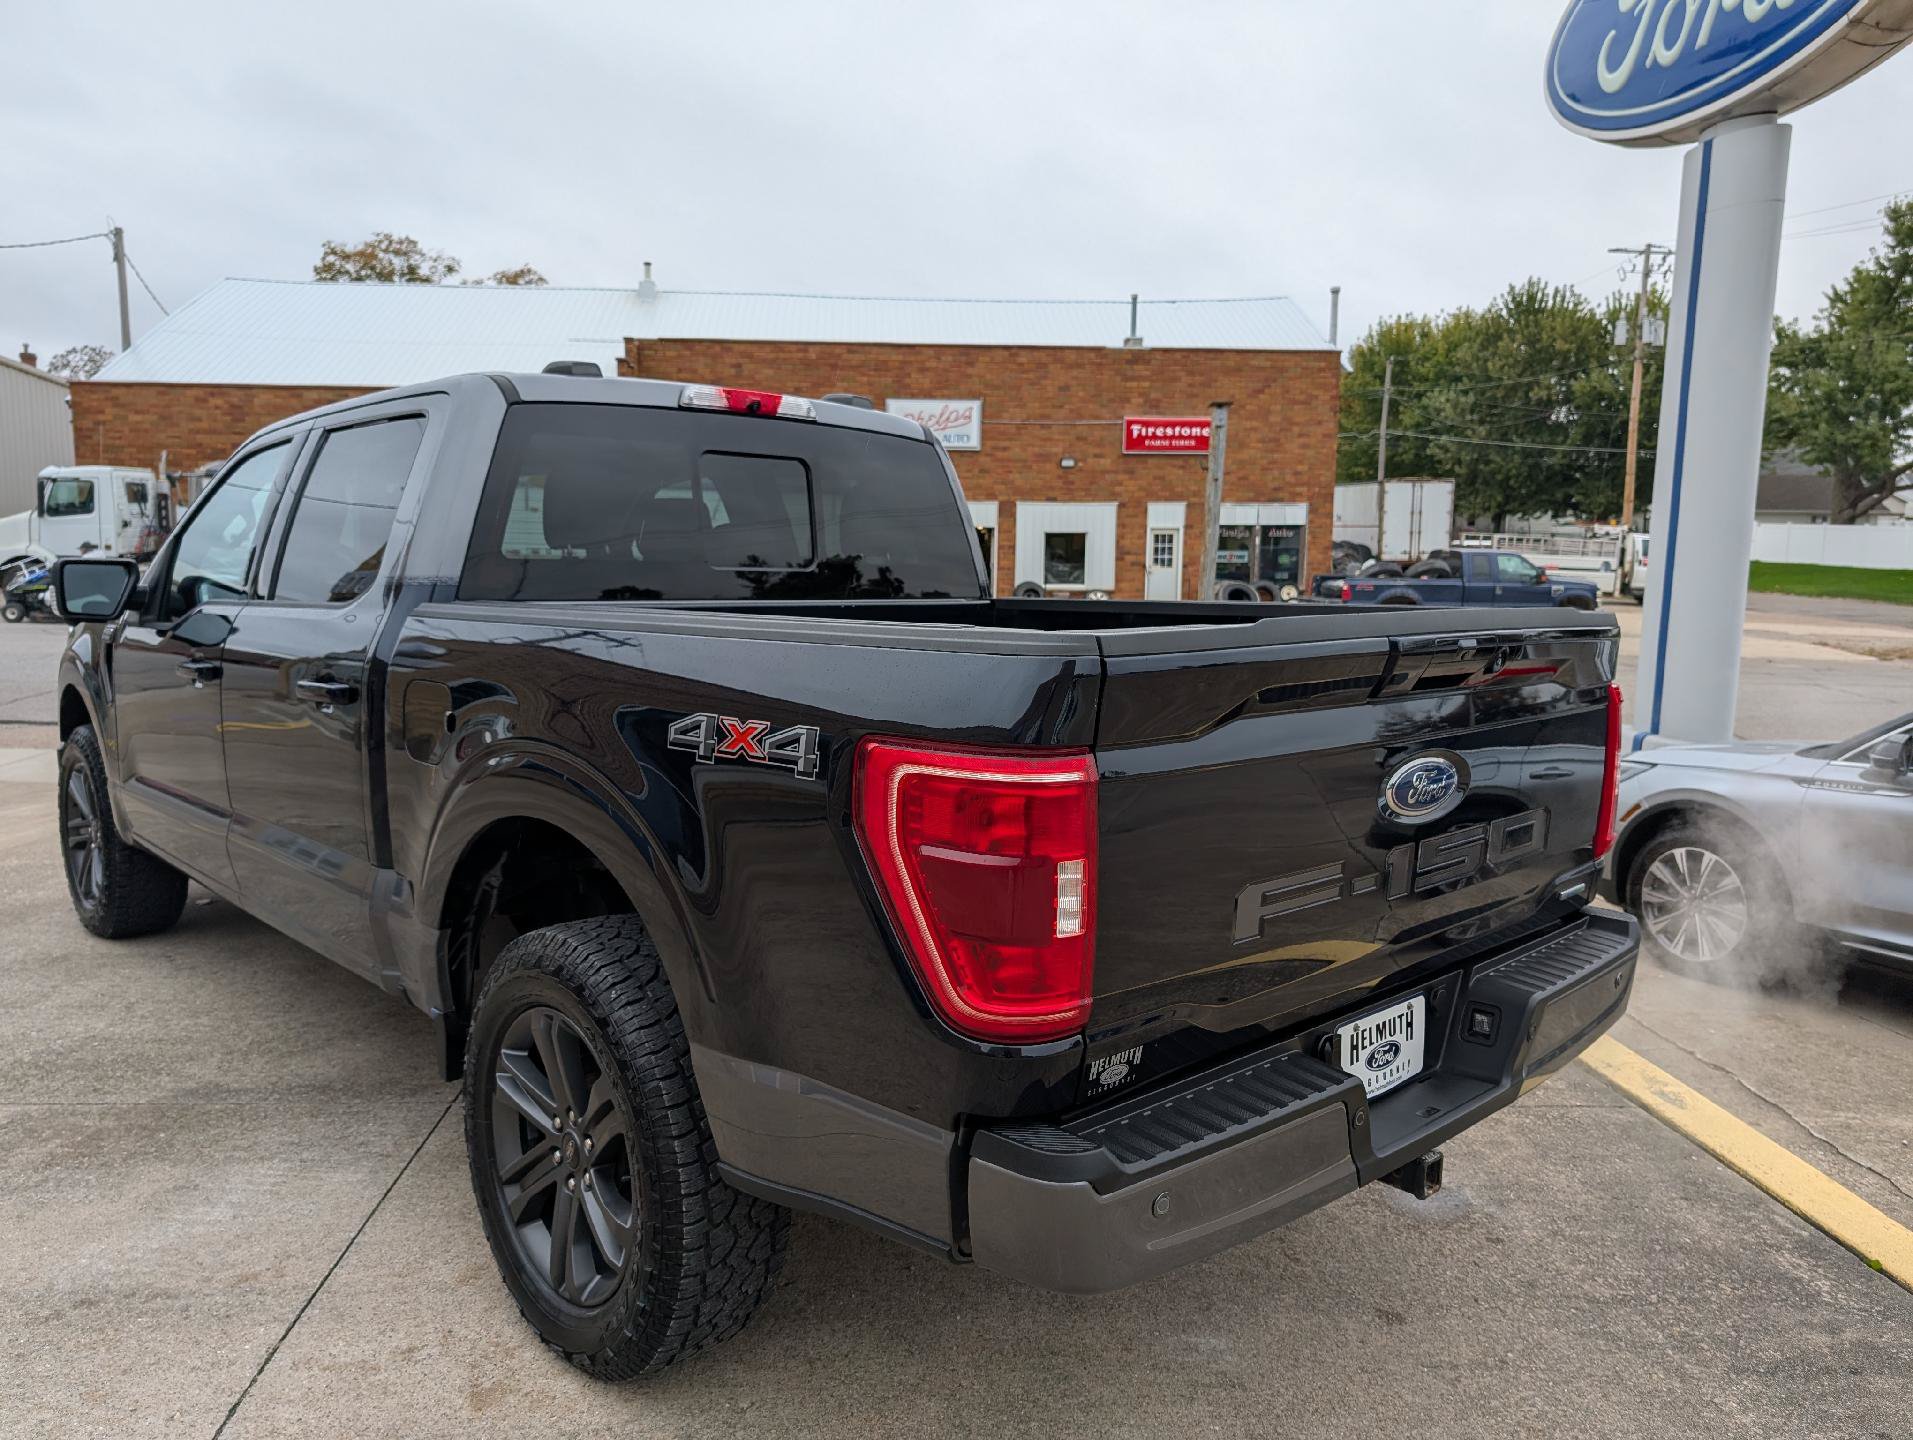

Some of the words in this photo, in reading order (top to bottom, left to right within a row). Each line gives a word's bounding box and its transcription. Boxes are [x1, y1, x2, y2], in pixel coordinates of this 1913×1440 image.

[1130, 424, 1211, 439] Firestone
[1407, 770, 1447, 804] Ford
[1233, 807, 1550, 946] F-150
[1349, 1010, 1414, 1066] HELMUTH
[1089, 1045, 1143, 1080] HELMUTH
[1372, 1045, 1396, 1068] Ford
